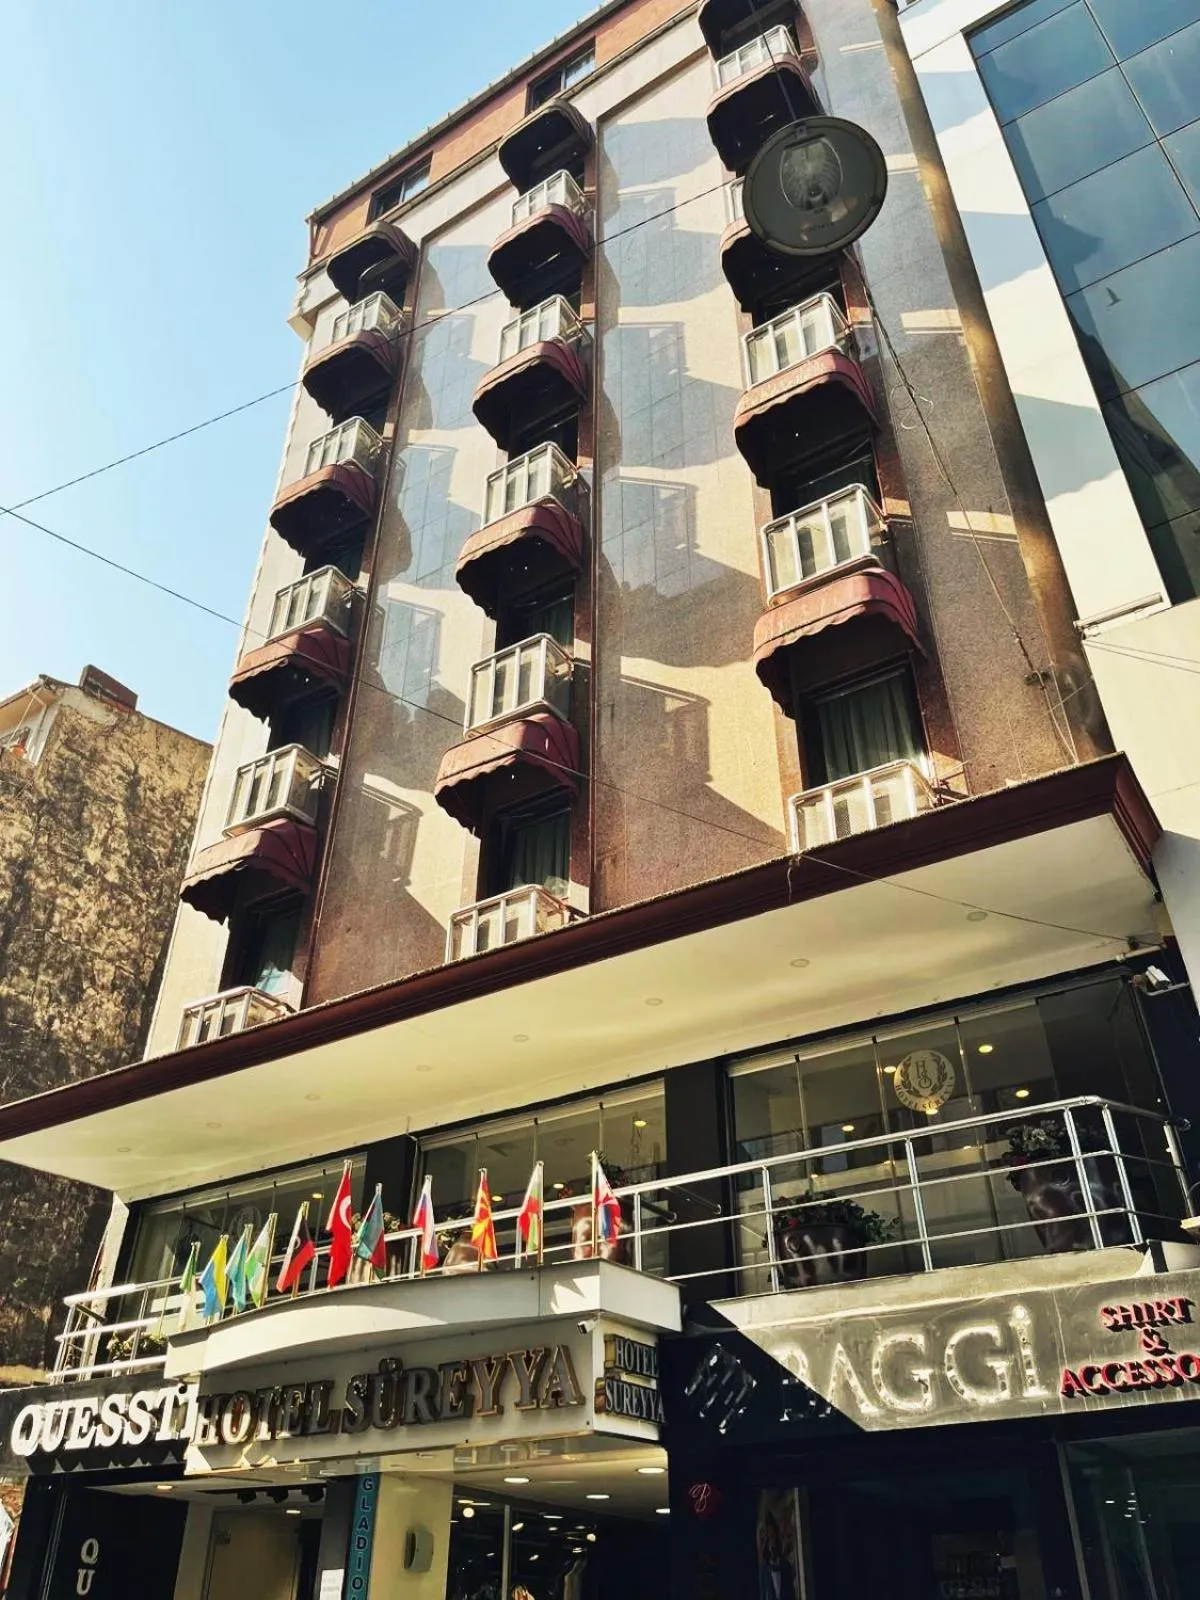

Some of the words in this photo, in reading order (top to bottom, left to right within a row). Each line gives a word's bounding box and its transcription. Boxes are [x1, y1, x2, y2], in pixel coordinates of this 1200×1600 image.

[1100, 1296, 1194, 1330] SHIRT
[615, 1337, 659, 1378] HOTEL
[1139, 1326, 1172, 1355] &
[1060, 1352, 1200, 1397] ACCESSO
[192, 1379, 335, 1447] HOTEL
[341, 1344, 586, 1434] SÜREYYA
